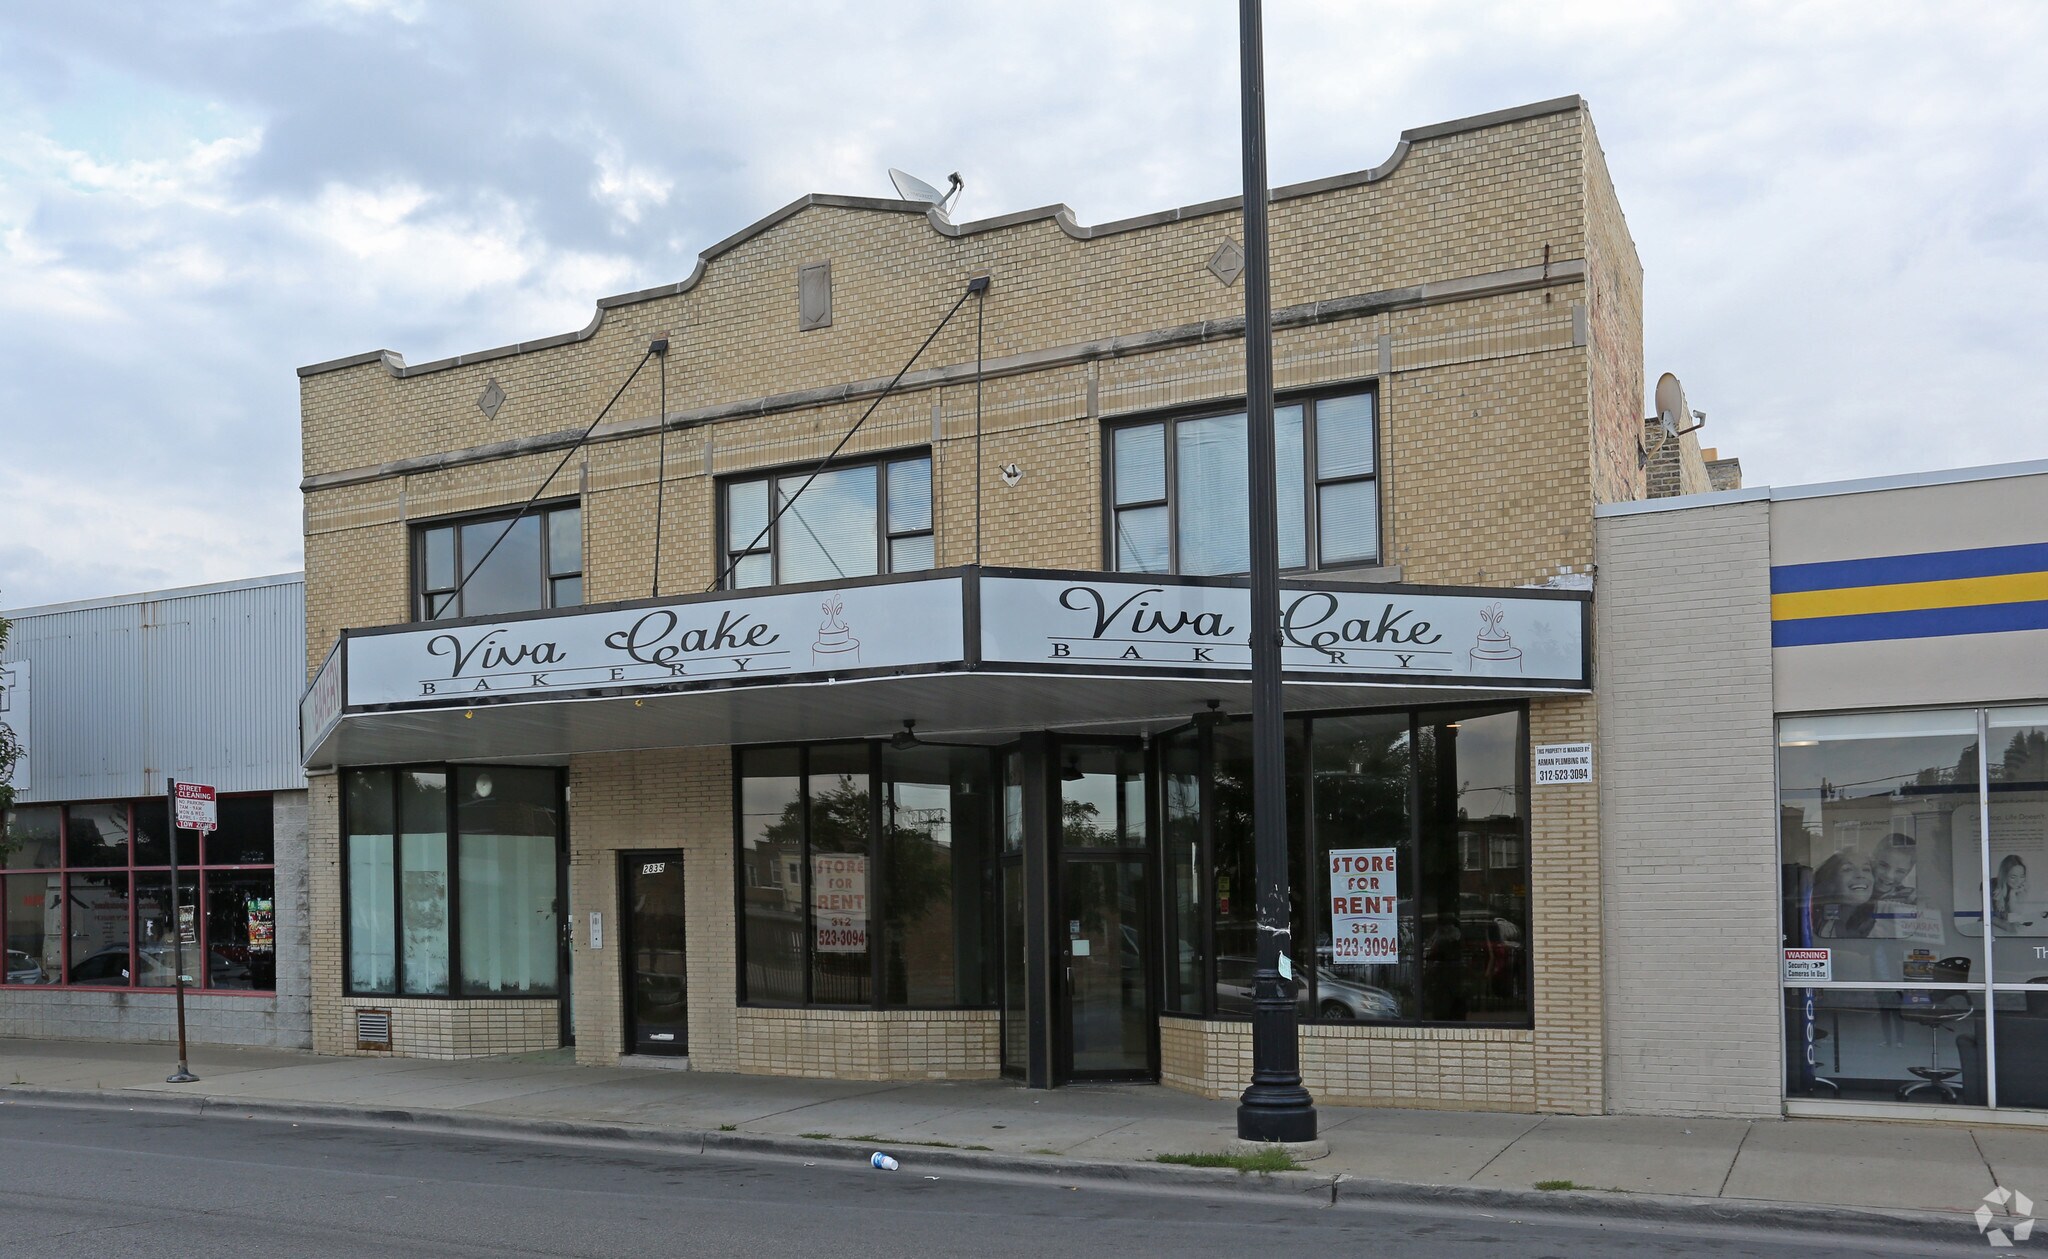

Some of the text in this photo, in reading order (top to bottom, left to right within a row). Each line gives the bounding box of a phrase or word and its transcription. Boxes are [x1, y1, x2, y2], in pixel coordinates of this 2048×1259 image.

[1059, 586, 1443, 656] Viva Cake
[427, 610, 781, 678] Viva Cake
[1051, 643, 1416, 668] BAKRY
[1538, 758, 1554, 766] ARMAN
[1555, 757, 1579, 765] PLUMBING
[1539, 768, 1588, 781] 312-523-3094
[178, 784, 202, 793] STREET
[178, 791, 211, 800] CLEANING
[643, 863, 665, 874] 2835
[817, 859, 865, 875] STORE
[1332, 855, 1395, 874] STORE
[828, 878, 853, 889] FOR
[1347, 877, 1380, 891] FOR
[817, 894, 865, 910] RENT
[1333, 896, 1396, 915] RENT
[831, 916, 852, 927] 312
[1351, 923, 1379, 934] 312
[818, 929, 865, 946] 523-3094
[1335, 936, 1397, 957] 523-3094
[1787, 951, 1827, 959] WARNING
[1788, 961, 1810, 970] Security
